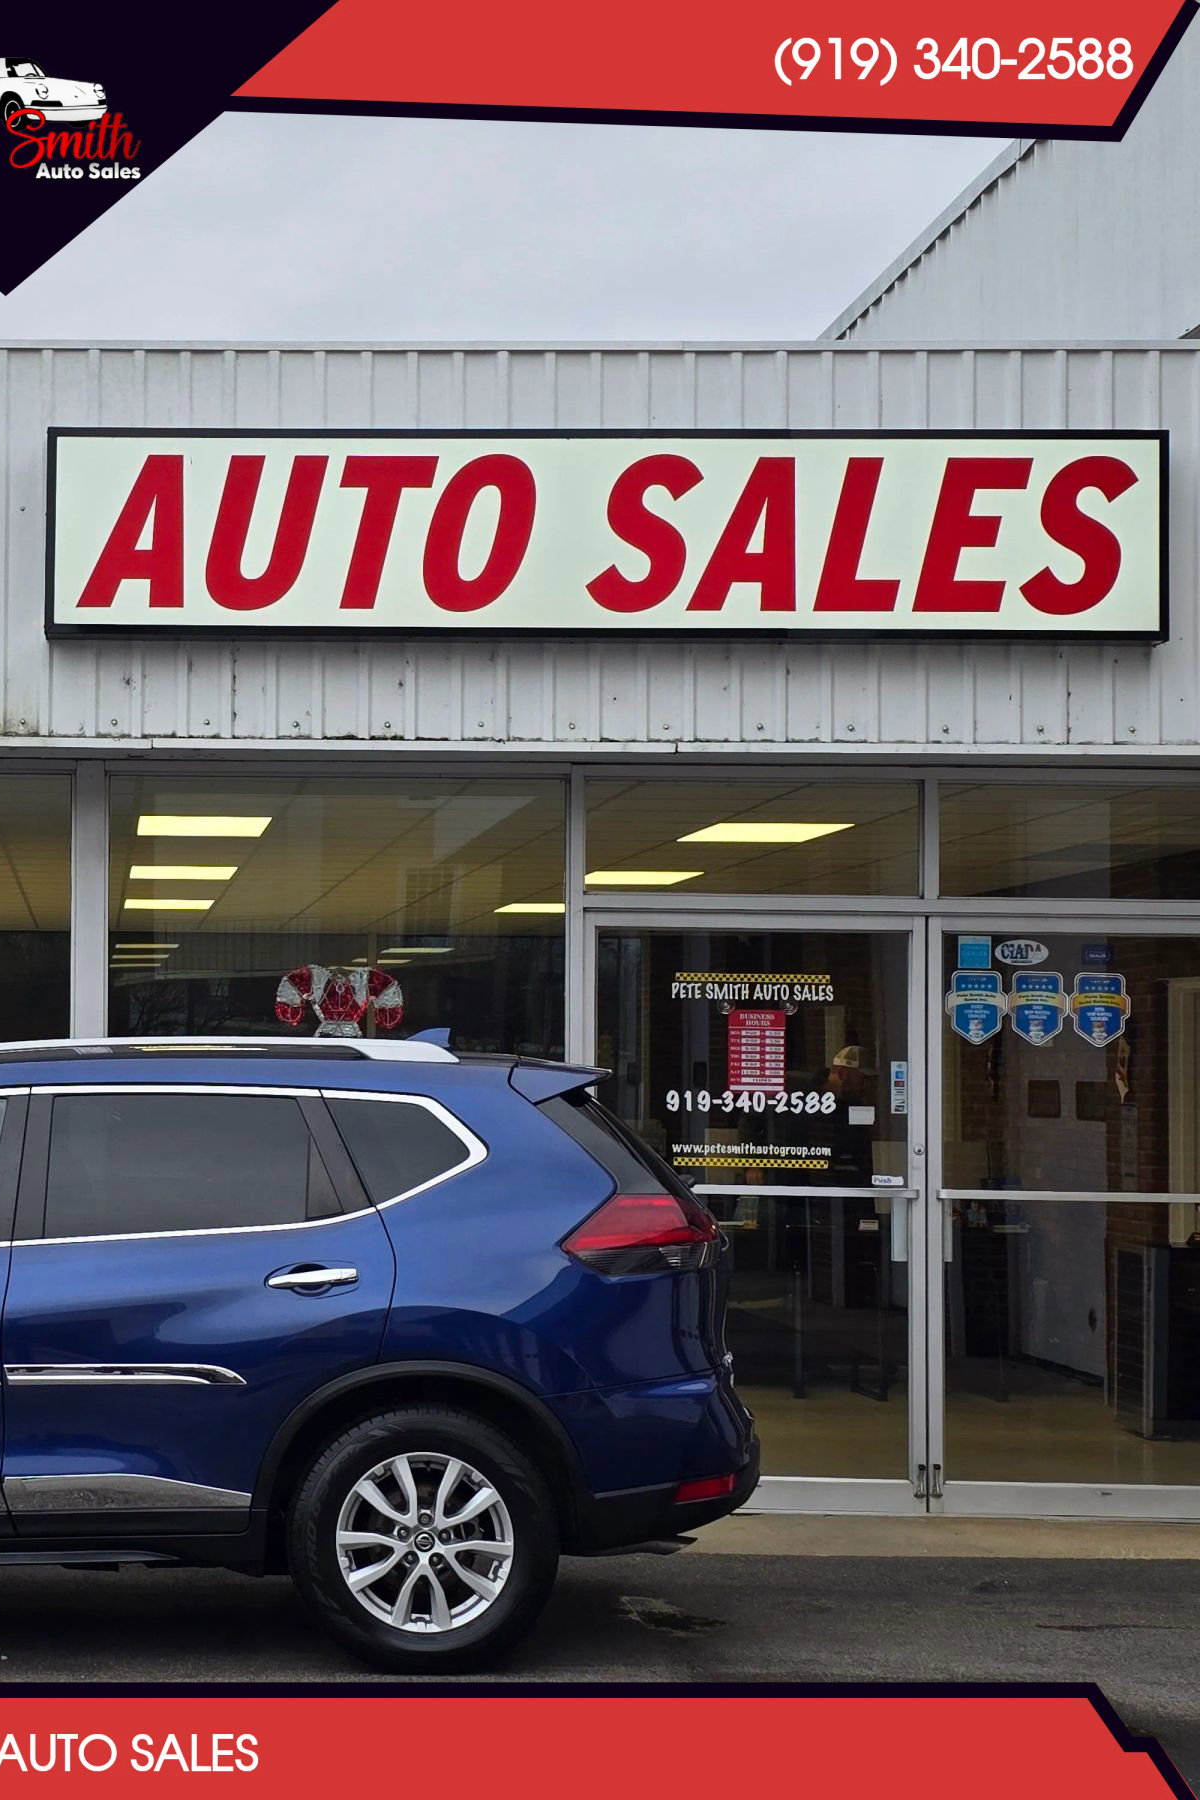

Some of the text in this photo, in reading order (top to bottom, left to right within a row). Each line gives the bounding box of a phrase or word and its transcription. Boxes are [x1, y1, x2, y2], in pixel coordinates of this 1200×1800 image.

[79, 455, 1137, 615] AUTO SALES
[671, 982, 835, 1002] PETE SMITH AUTO SALES
[666, 1090, 837, 1114] 919-340-2588
[671, 1142, 832, 1158] www.petesmithautogroup.com
